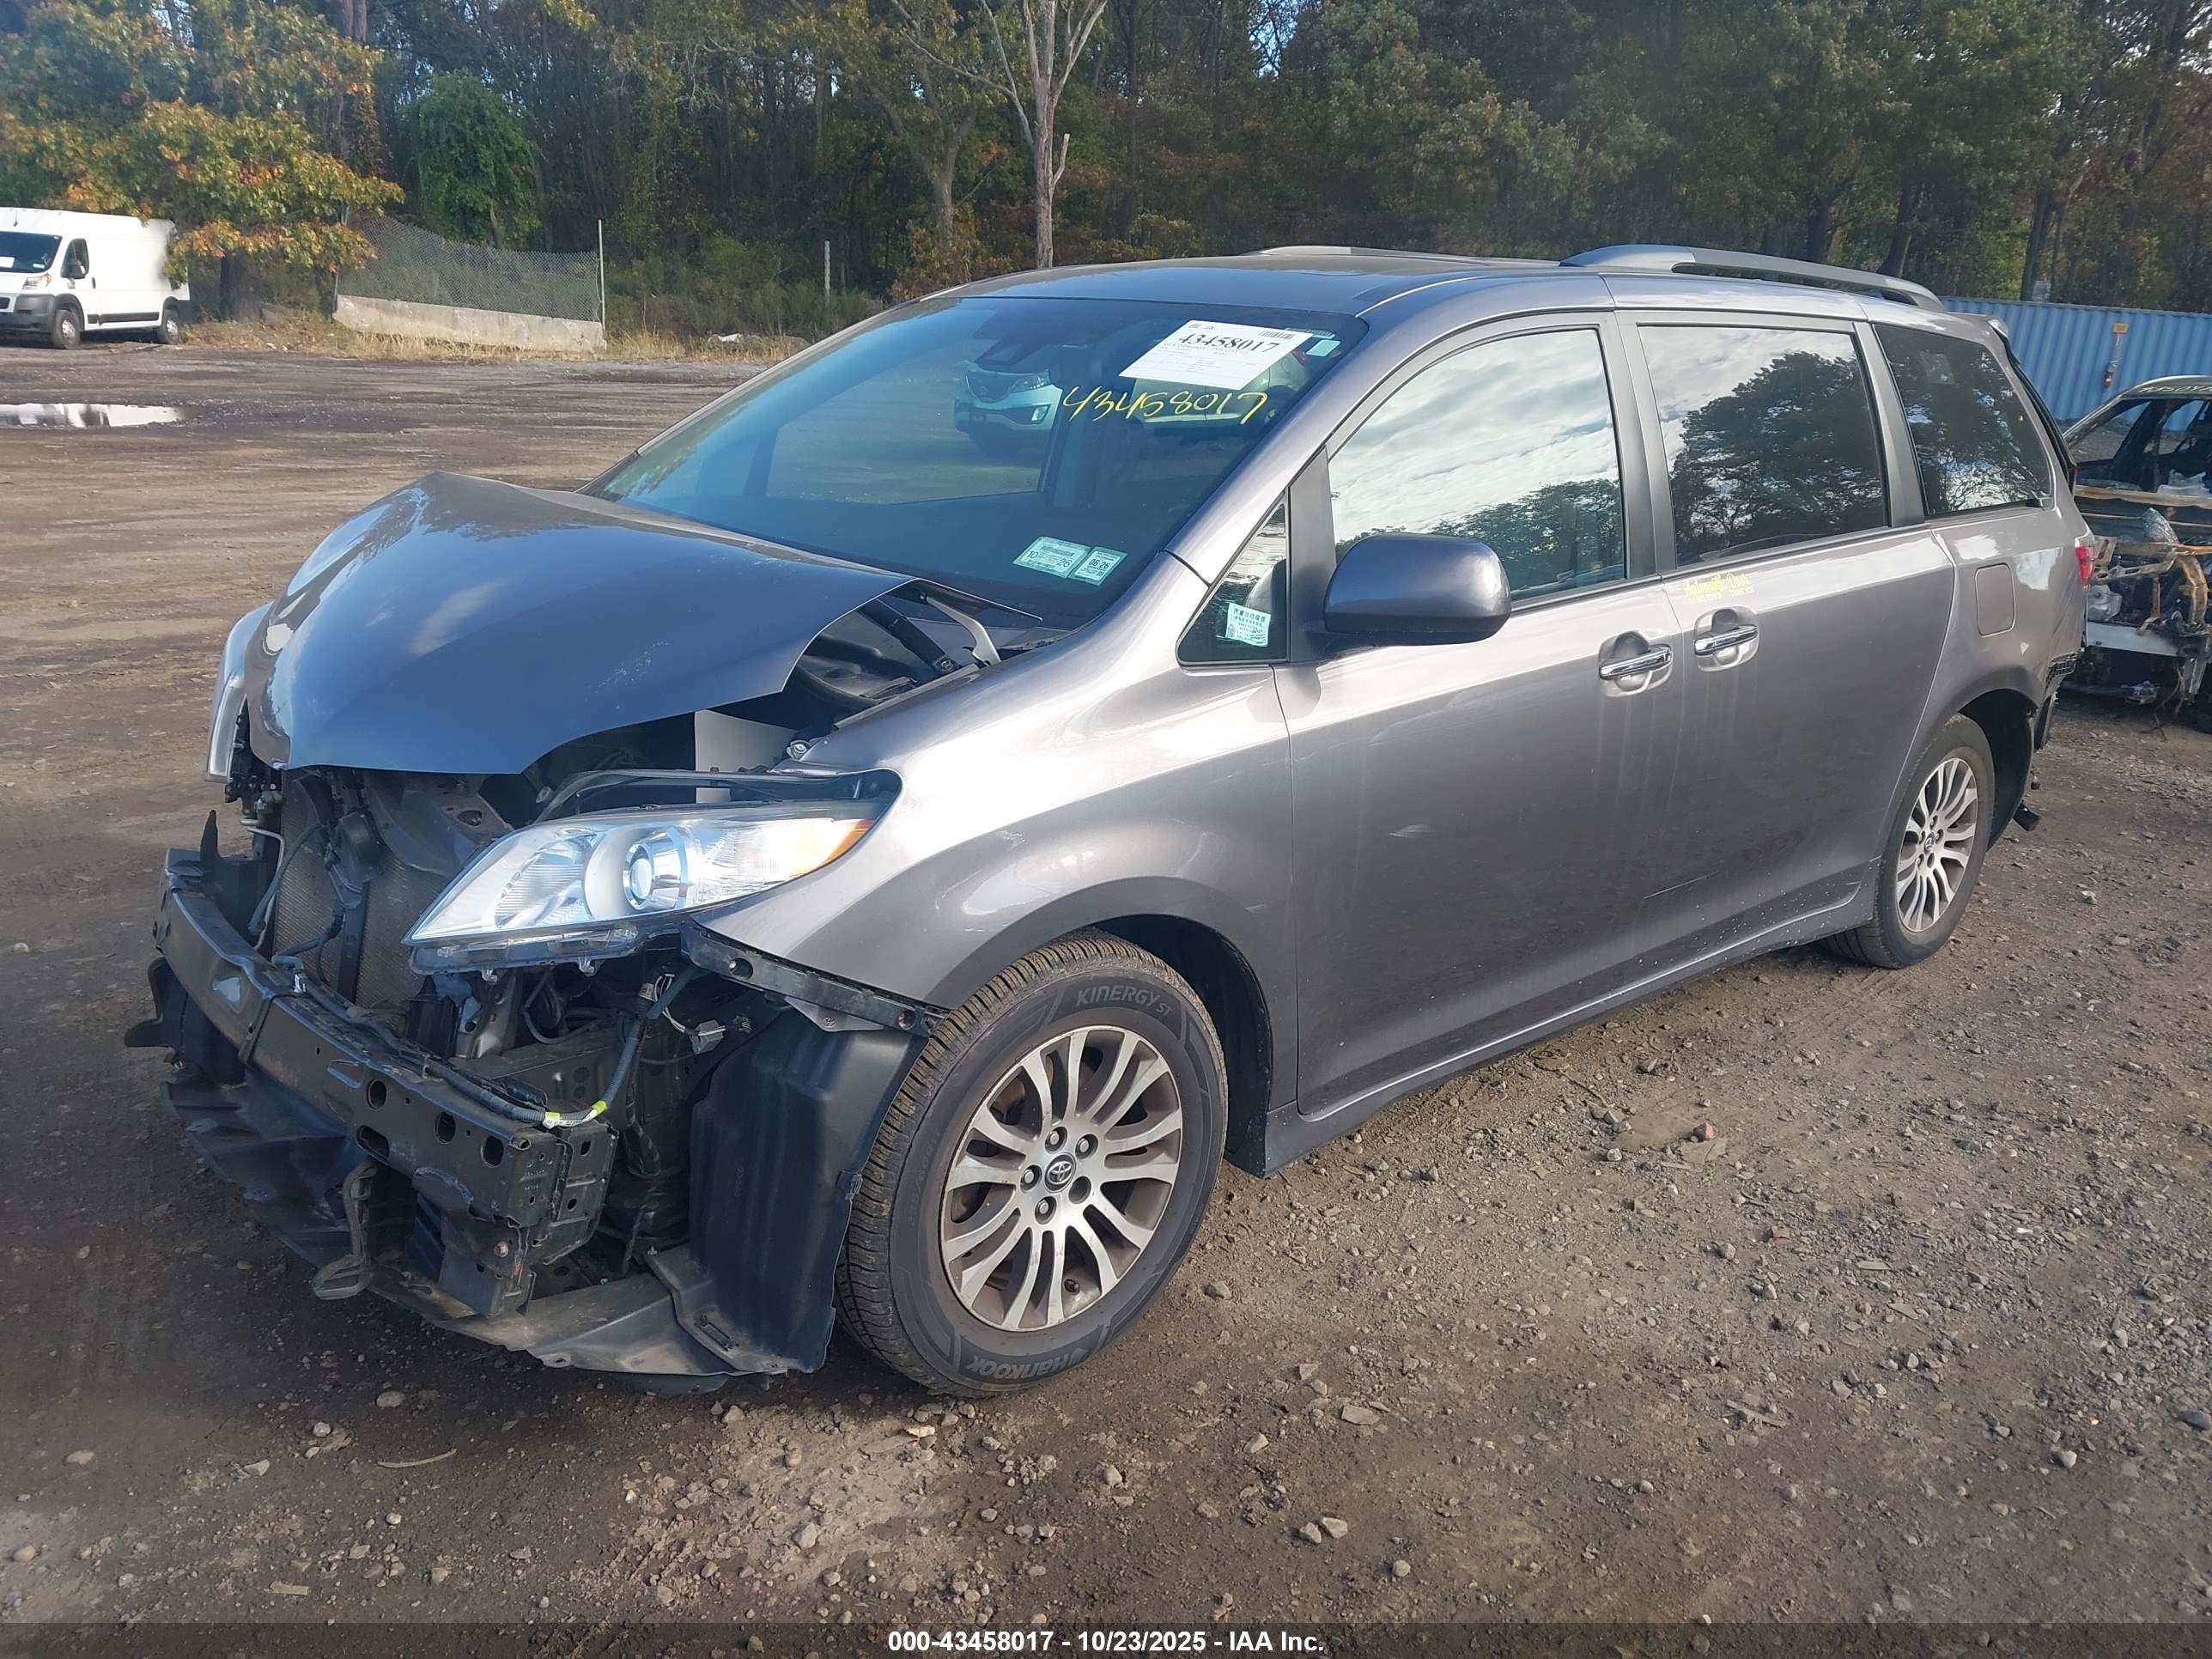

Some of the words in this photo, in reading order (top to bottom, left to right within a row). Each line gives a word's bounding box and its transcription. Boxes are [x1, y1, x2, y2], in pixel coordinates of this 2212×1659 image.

[1179, 332, 1280, 353] 43458017
[1063, 386, 1268, 425] 43458017
[1076, 986, 1159, 1006] KINERGY
[1156, 1002, 1173, 1016] ST
